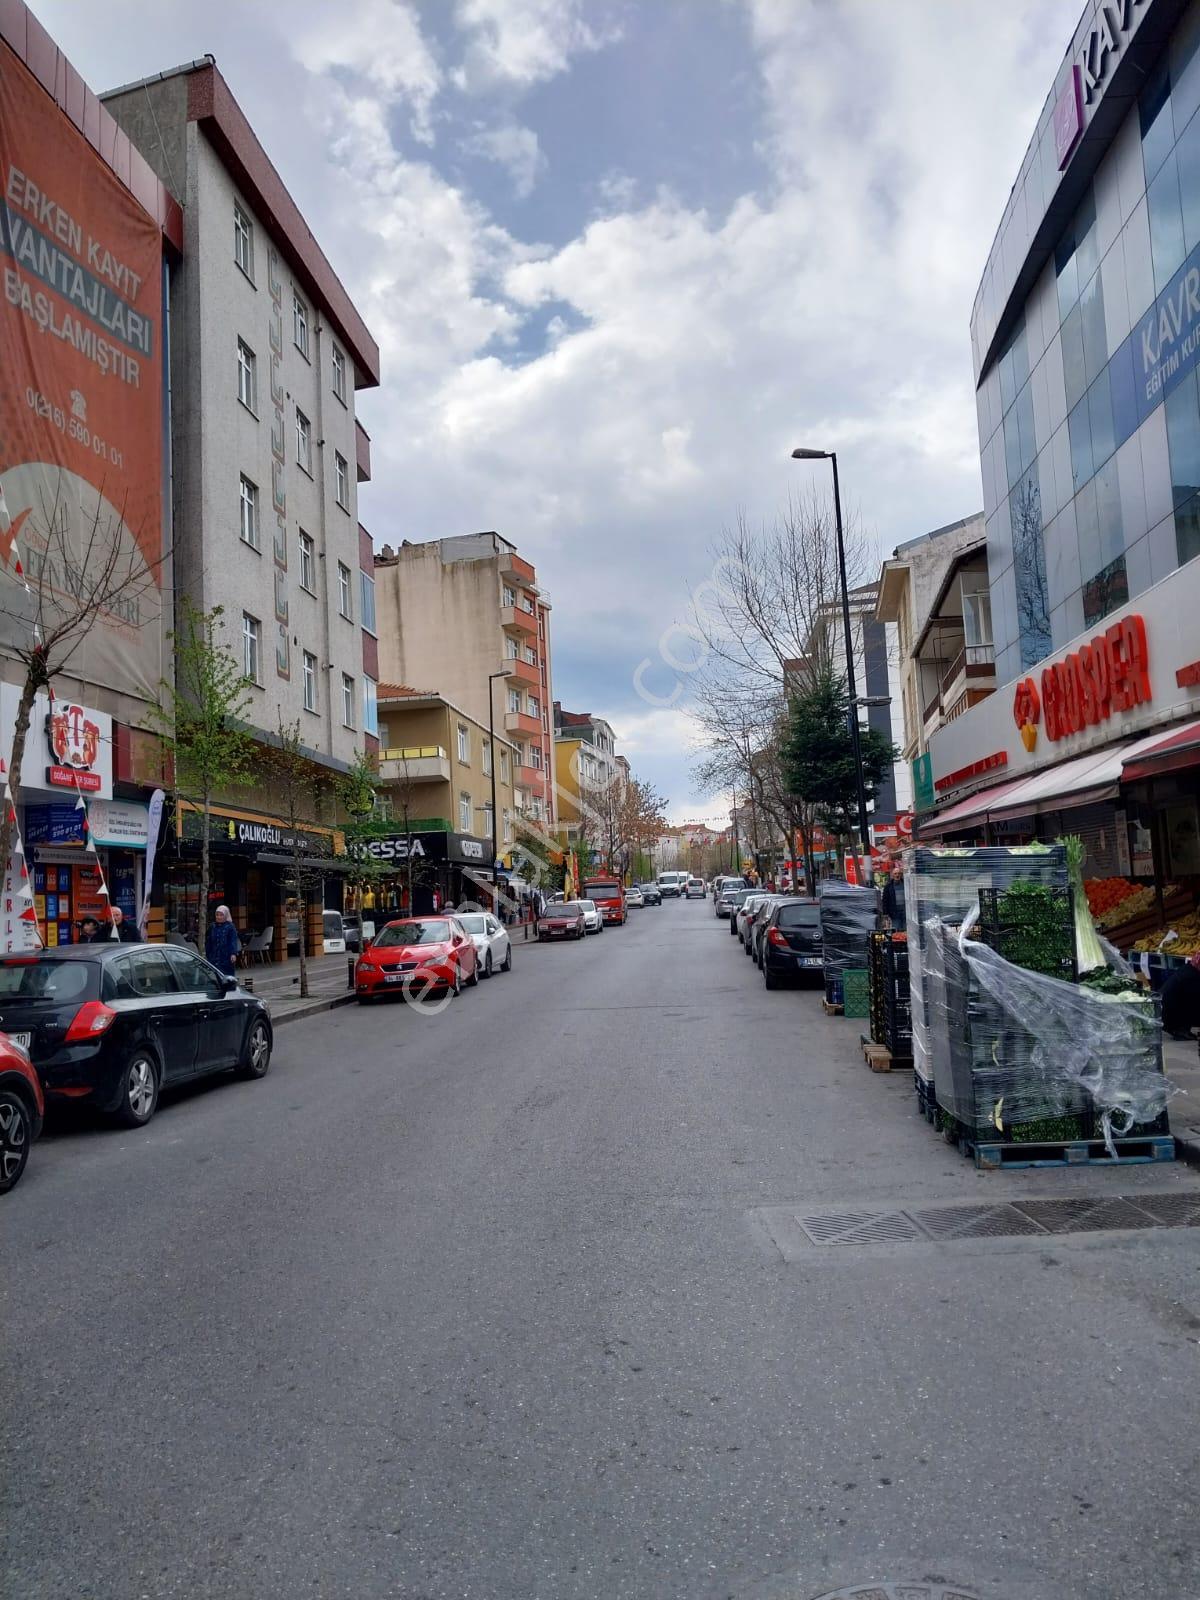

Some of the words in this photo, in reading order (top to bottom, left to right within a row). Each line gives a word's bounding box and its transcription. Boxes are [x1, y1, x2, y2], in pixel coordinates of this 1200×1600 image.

[1082, 0, 1146, 106] KAV
[7, 164, 82, 255] ERKEN
[87, 235, 141, 301] KAYIT
[4, 267, 140, 388] BAŞLAMIŞTIR
[1146, 350, 1179, 401] EĞİTİM
[26, 386, 66, 434] 0(216)
[93, 435, 106, 460] 01
[111, 447, 123, 470] 01
[240, 823, 280, 845] ÇALIKOĞLU
